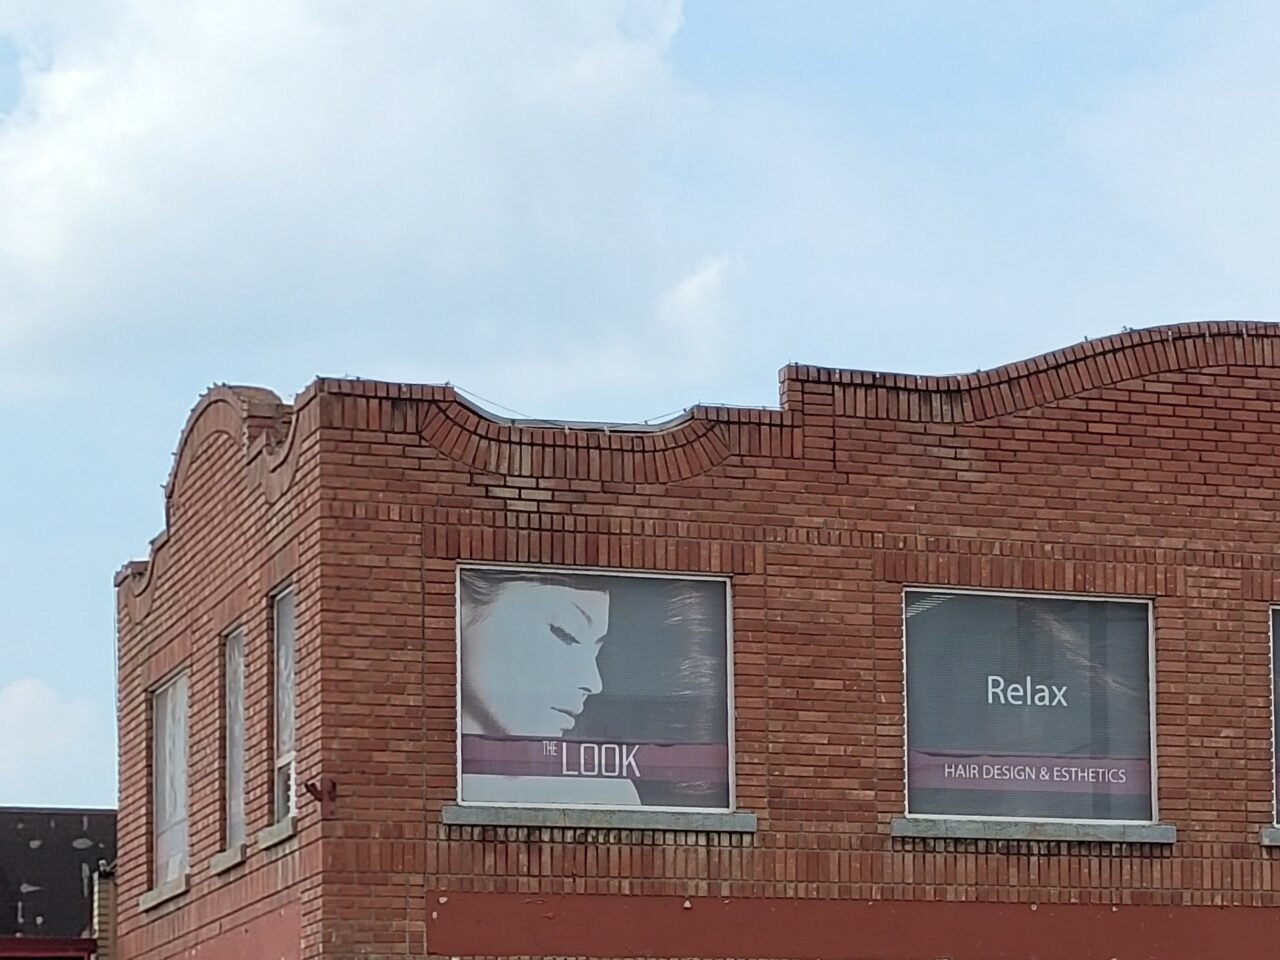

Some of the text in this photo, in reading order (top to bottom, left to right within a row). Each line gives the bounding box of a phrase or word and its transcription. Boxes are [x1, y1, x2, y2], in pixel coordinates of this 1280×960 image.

[987, 675, 1068, 707] Relax
[542, 741, 641, 777] THE LOOK
[944, 763, 1127, 783] HAIR DESIGN & ESTHETICS
